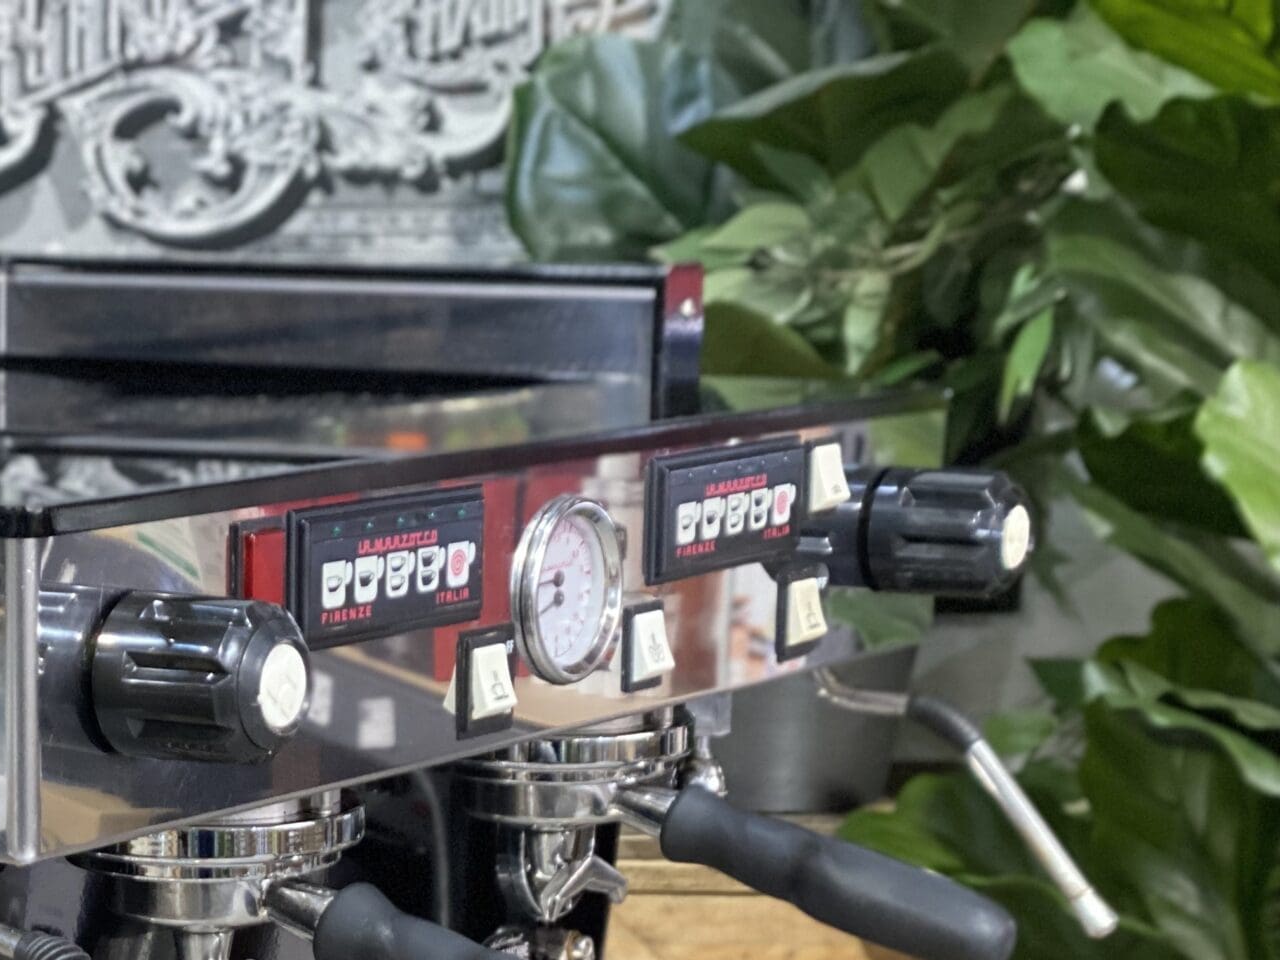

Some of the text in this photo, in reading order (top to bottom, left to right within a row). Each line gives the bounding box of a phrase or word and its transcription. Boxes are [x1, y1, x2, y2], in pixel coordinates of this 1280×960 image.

[676, 540, 716, 558] FIRENZE
[435, 588, 469, 605] ITALIA
[321, 605, 372, 624] FIRENZE
